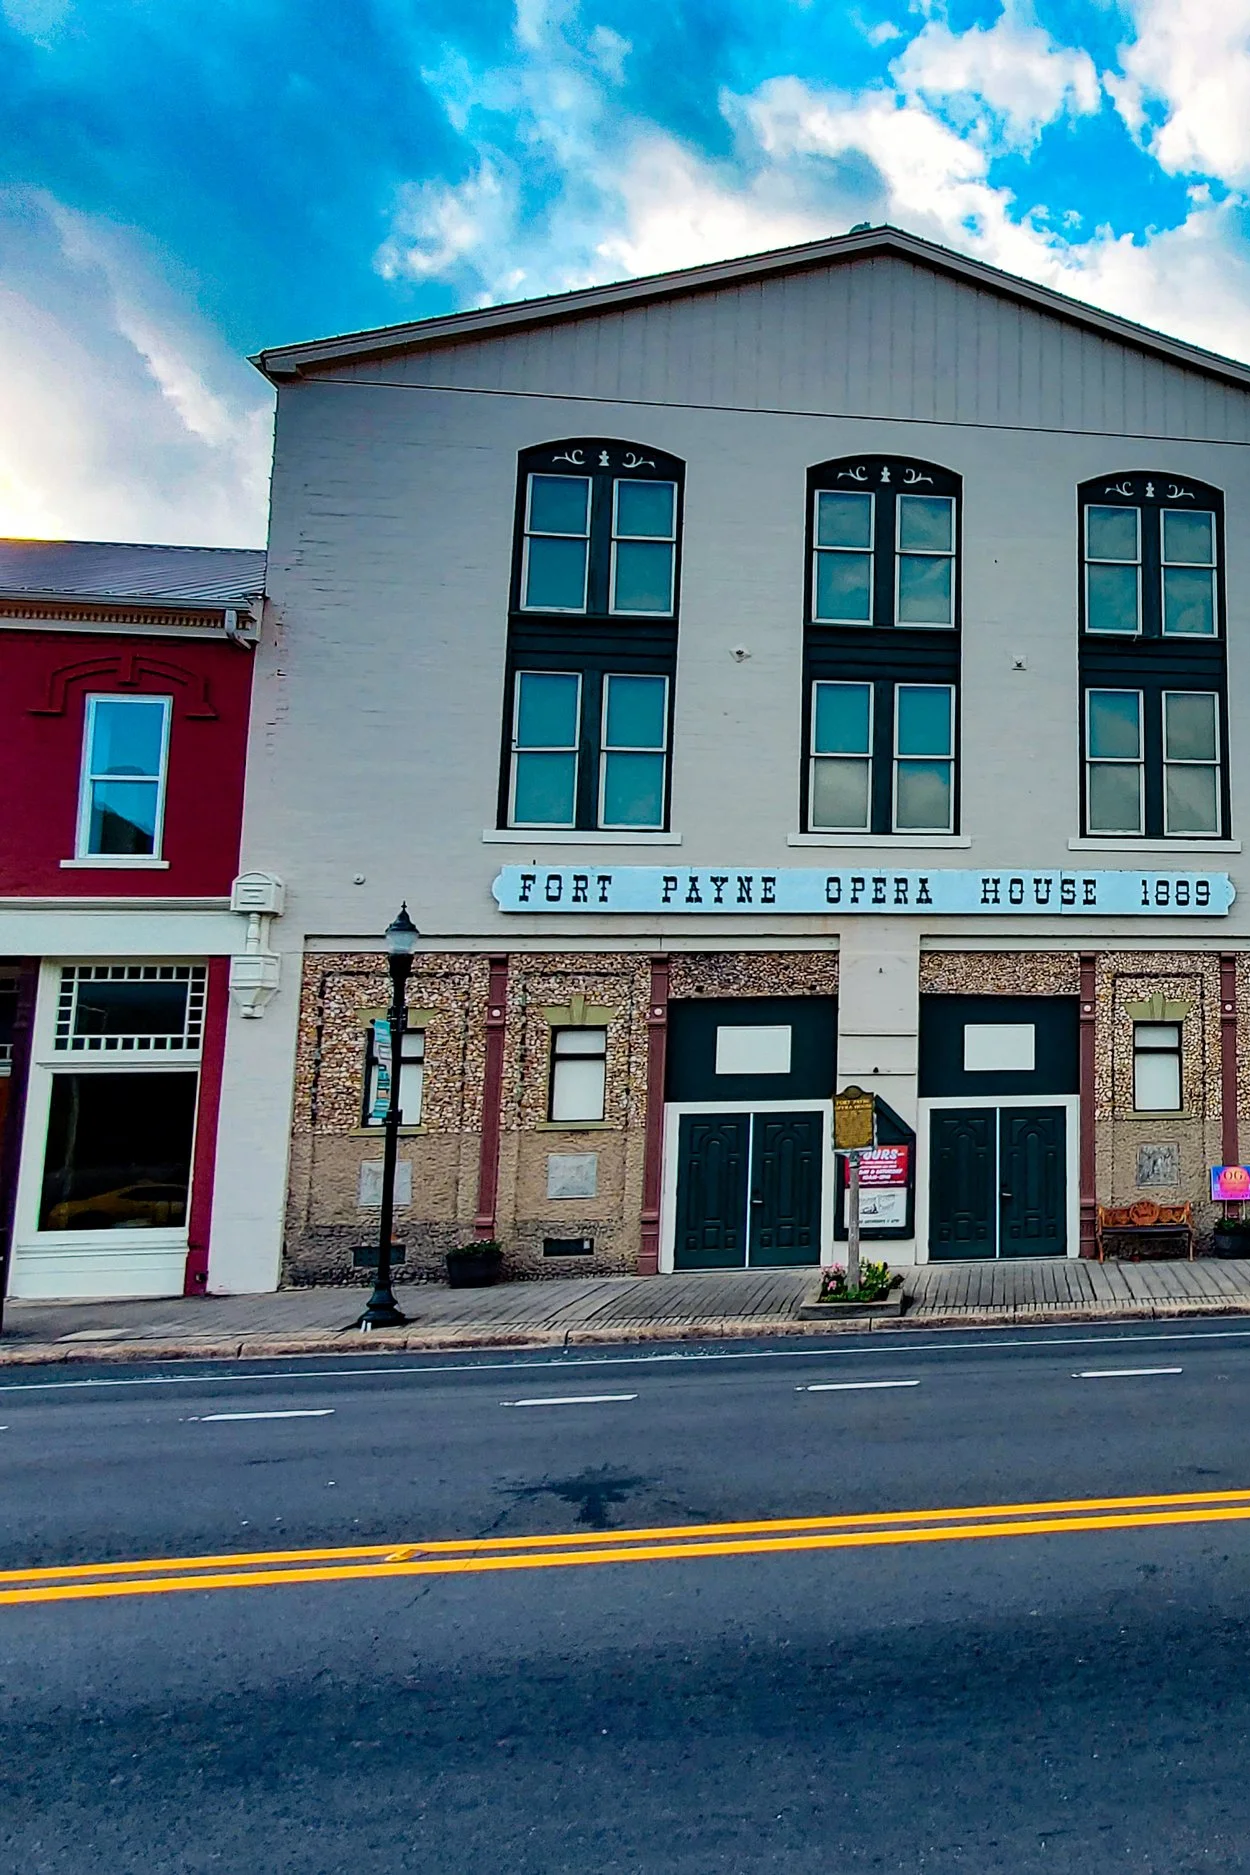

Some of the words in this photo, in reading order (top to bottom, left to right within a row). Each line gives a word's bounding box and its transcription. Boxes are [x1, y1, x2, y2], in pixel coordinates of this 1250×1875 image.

[518, 873, 613, 903] FORT
[661, 875, 777, 904] PAYNE
[825, 876, 933, 905] OPERA
[980, 877, 1097, 906] HOUSE
[1141, 879, 1211, 907] 1889
